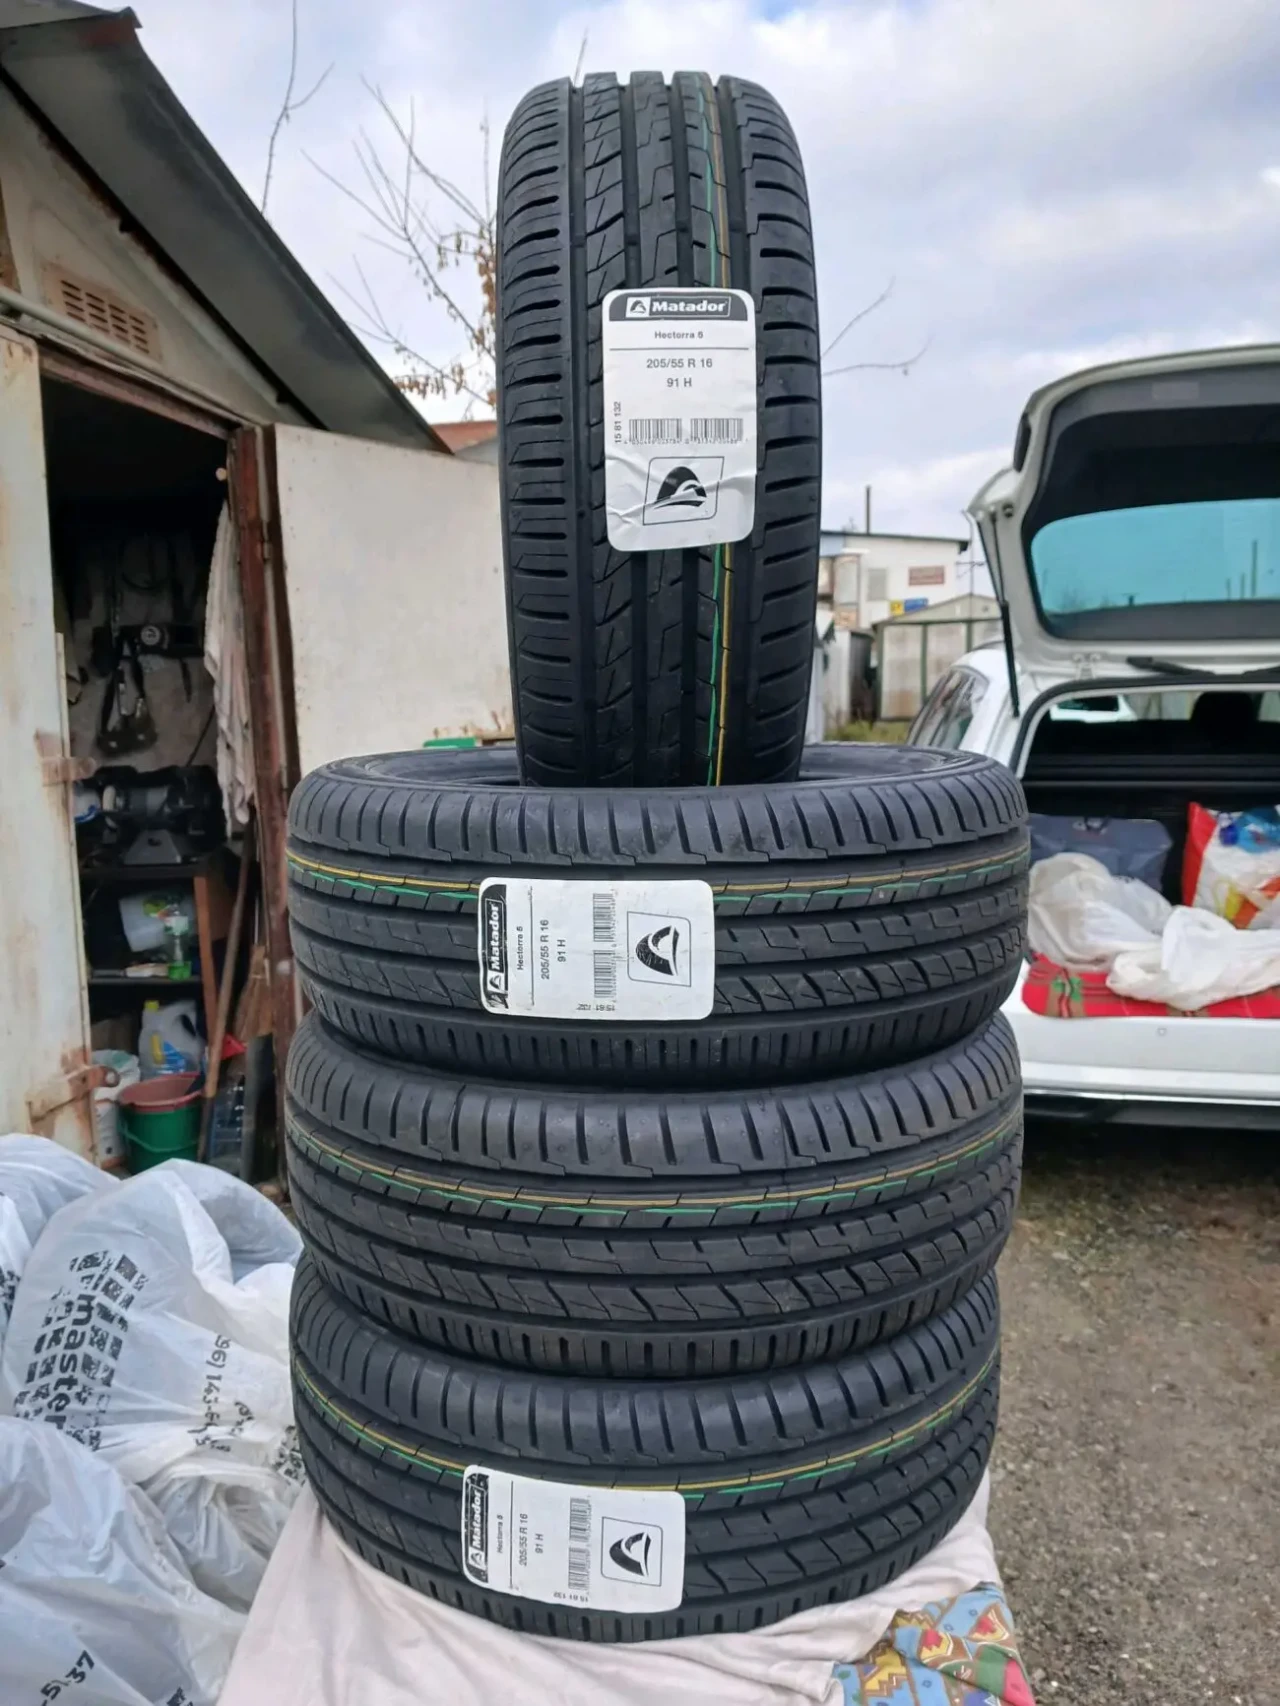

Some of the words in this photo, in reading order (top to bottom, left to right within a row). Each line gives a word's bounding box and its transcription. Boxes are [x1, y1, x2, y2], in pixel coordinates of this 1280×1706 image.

[651, 300, 727, 312] Matador
[654, 331, 695, 339] Hectorra
[646, 358, 685, 369] 205/55
[687, 358, 696, 368] R
[700, 358, 713, 368] 16
[666, 378, 680, 388] 91
[683, 378, 692, 387] H
[613, 402, 621, 417] 132
[614, 420, 622, 432] 81
[614, 434, 622, 444] 15
[540, 919, 549, 932] 16
[488, 902, 501, 970] Matador
[540, 935, 549, 943] R
[557, 939, 566, 947] H
[516, 932, 524, 971] Hectorra
[557, 950, 567, 963] 91
[540, 945, 550, 980] 205/55
[44, 1293, 97, 1431] master
[470, 1488, 482, 1550] Matador
[519, 1513, 528, 1523] 16
[519, 1527, 528, 1535] R
[534, 1533, 544, 1541] H
[518, 1535, 528, 1567] 205/55
[534, 1541, 544, 1554] 91
